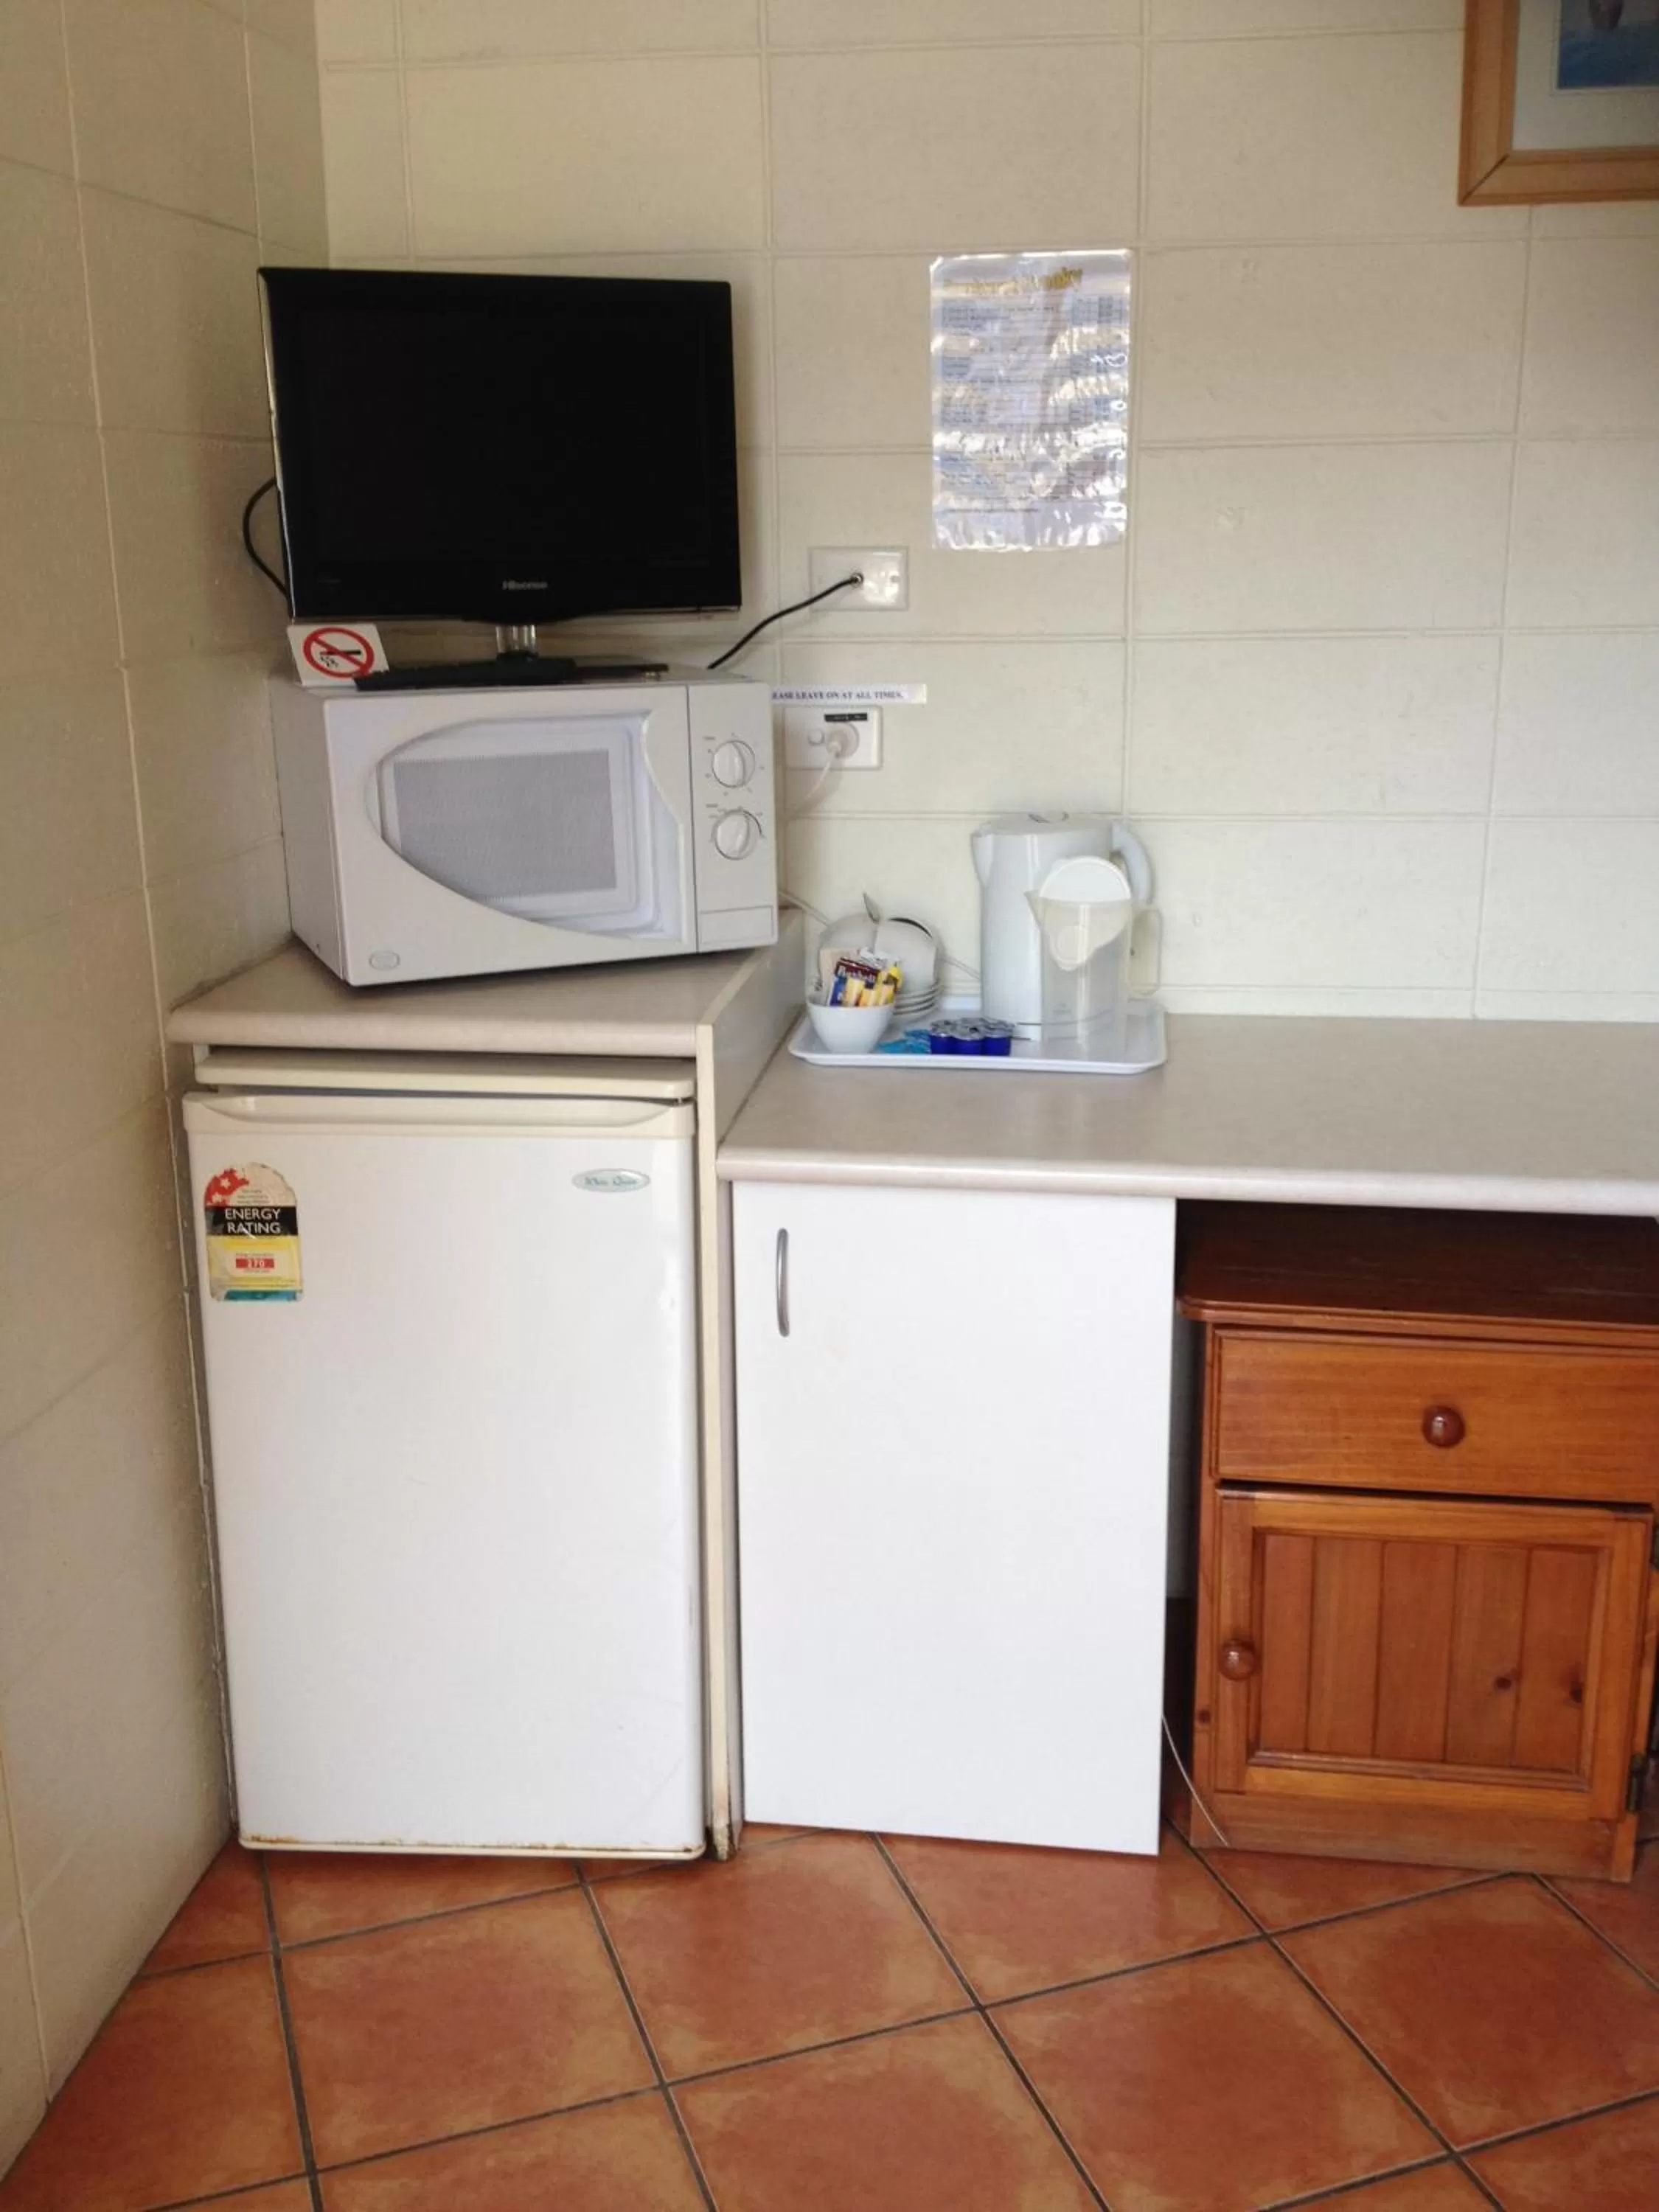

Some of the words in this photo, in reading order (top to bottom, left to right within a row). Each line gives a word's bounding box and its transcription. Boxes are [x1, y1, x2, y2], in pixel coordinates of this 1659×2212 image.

[796, 691, 824, 700] LEAVE
[826, 690, 840, 700] ON
[842, 690, 853, 700] AT
[856, 691, 872, 700] ALL
[224, 1208, 281, 1220] ENERGY
[227, 1221, 281, 1234] RATING
